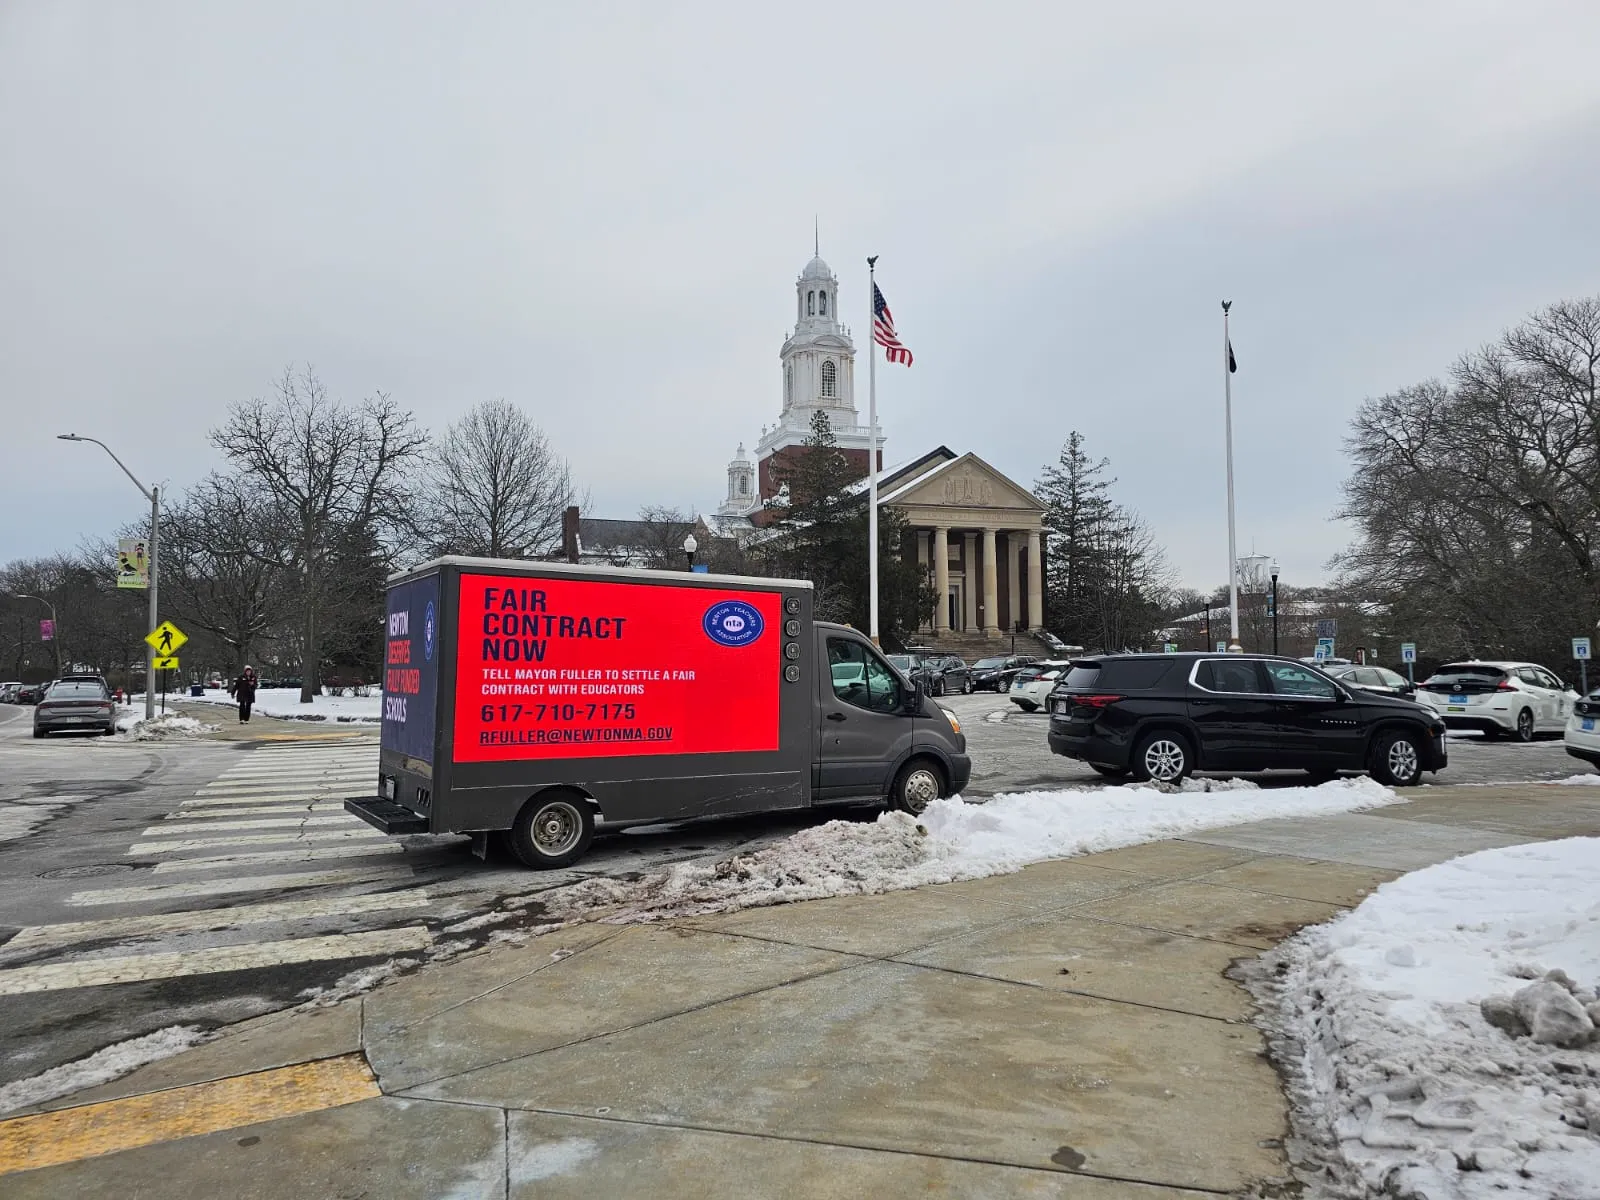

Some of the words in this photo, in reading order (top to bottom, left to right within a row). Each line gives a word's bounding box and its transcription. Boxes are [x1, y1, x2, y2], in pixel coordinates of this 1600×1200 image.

[484, 587, 547, 612] FAIR
[483, 613, 627, 640] CONTRACT
[482, 638, 547, 662] NOW
[482, 668, 512, 680] TELL
[515, 668, 557, 680] MAYOR
[560, 669, 602, 680] FULLER
[605, 669, 619, 680] TO
[621, 670, 660, 680] SETTLE
[662, 670, 670, 680] A
[672, 670, 696, 680] FAIR
[481, 684, 545, 695] CONTRACT
[548, 684, 578, 695] WITH
[581, 684, 645, 695] EDUCATORS
[481, 703, 636, 722] 617-710-7175
[480, 727, 673, 745] RFULLER@NEWTONMA.GOV
